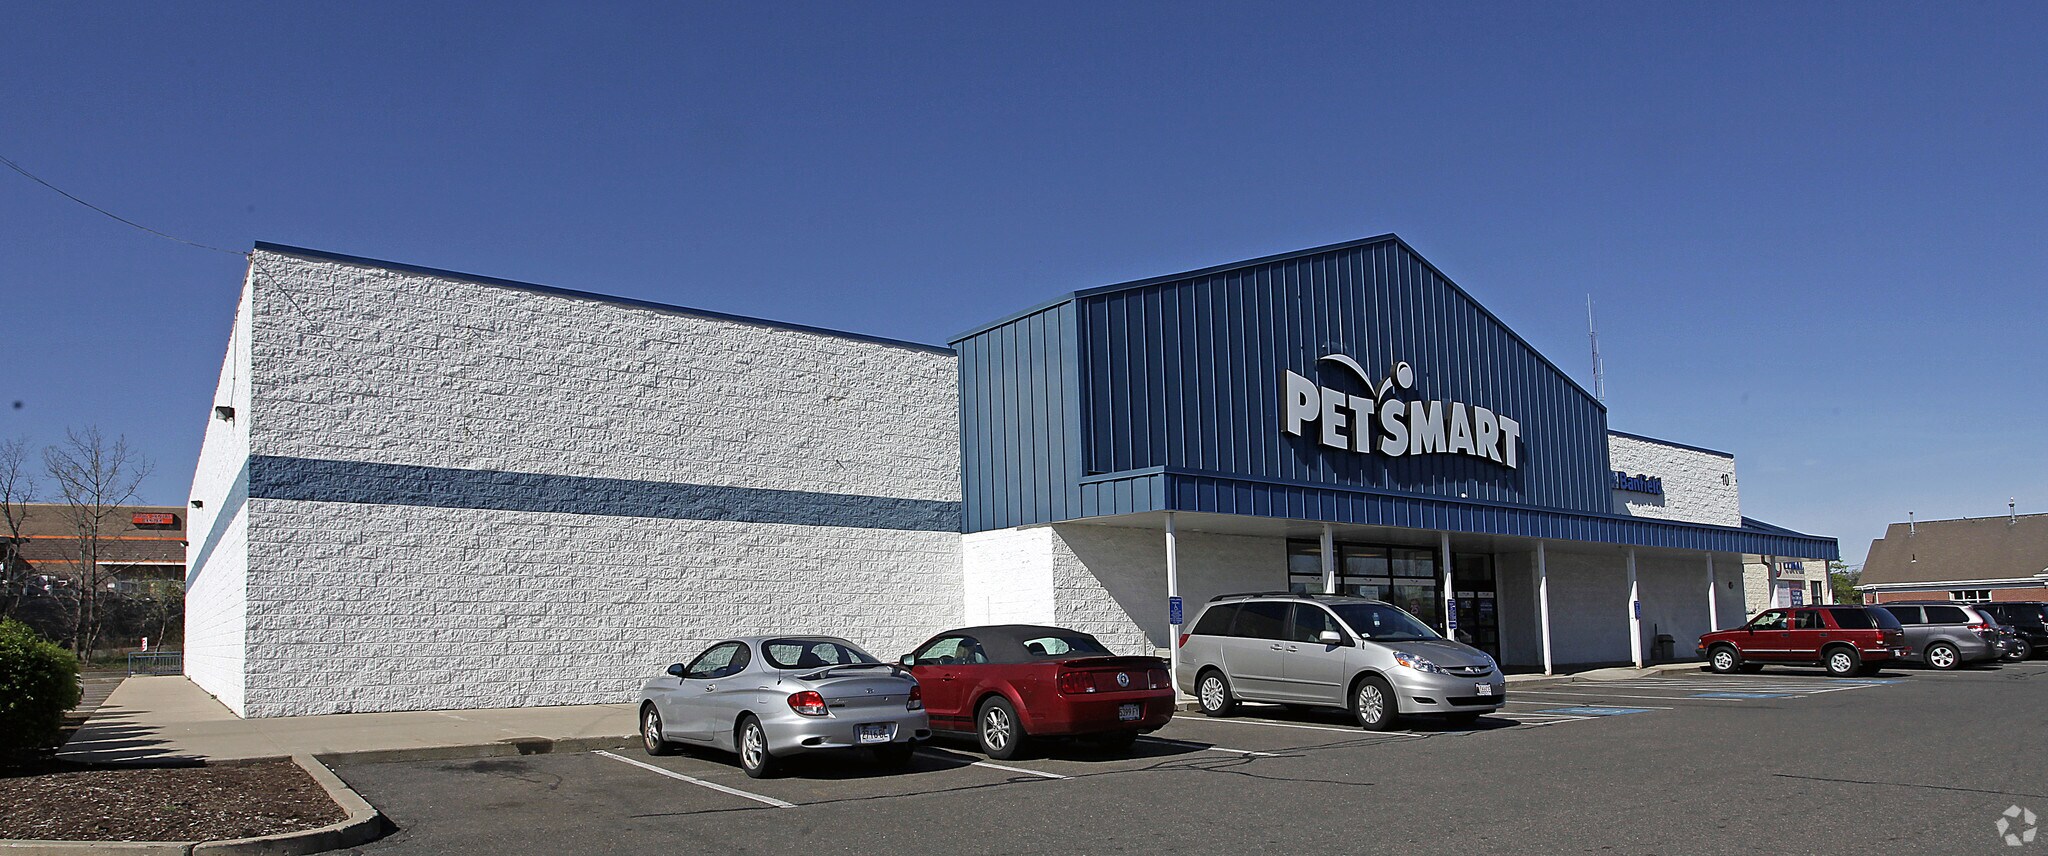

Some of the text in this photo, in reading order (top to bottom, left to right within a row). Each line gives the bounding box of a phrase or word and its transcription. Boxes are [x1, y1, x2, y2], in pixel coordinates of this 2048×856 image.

[1282, 368, 1520, 469] PETSMART
[1619, 471, 1662, 495] Banfield
[1721, 473, 1730, 486] 10
